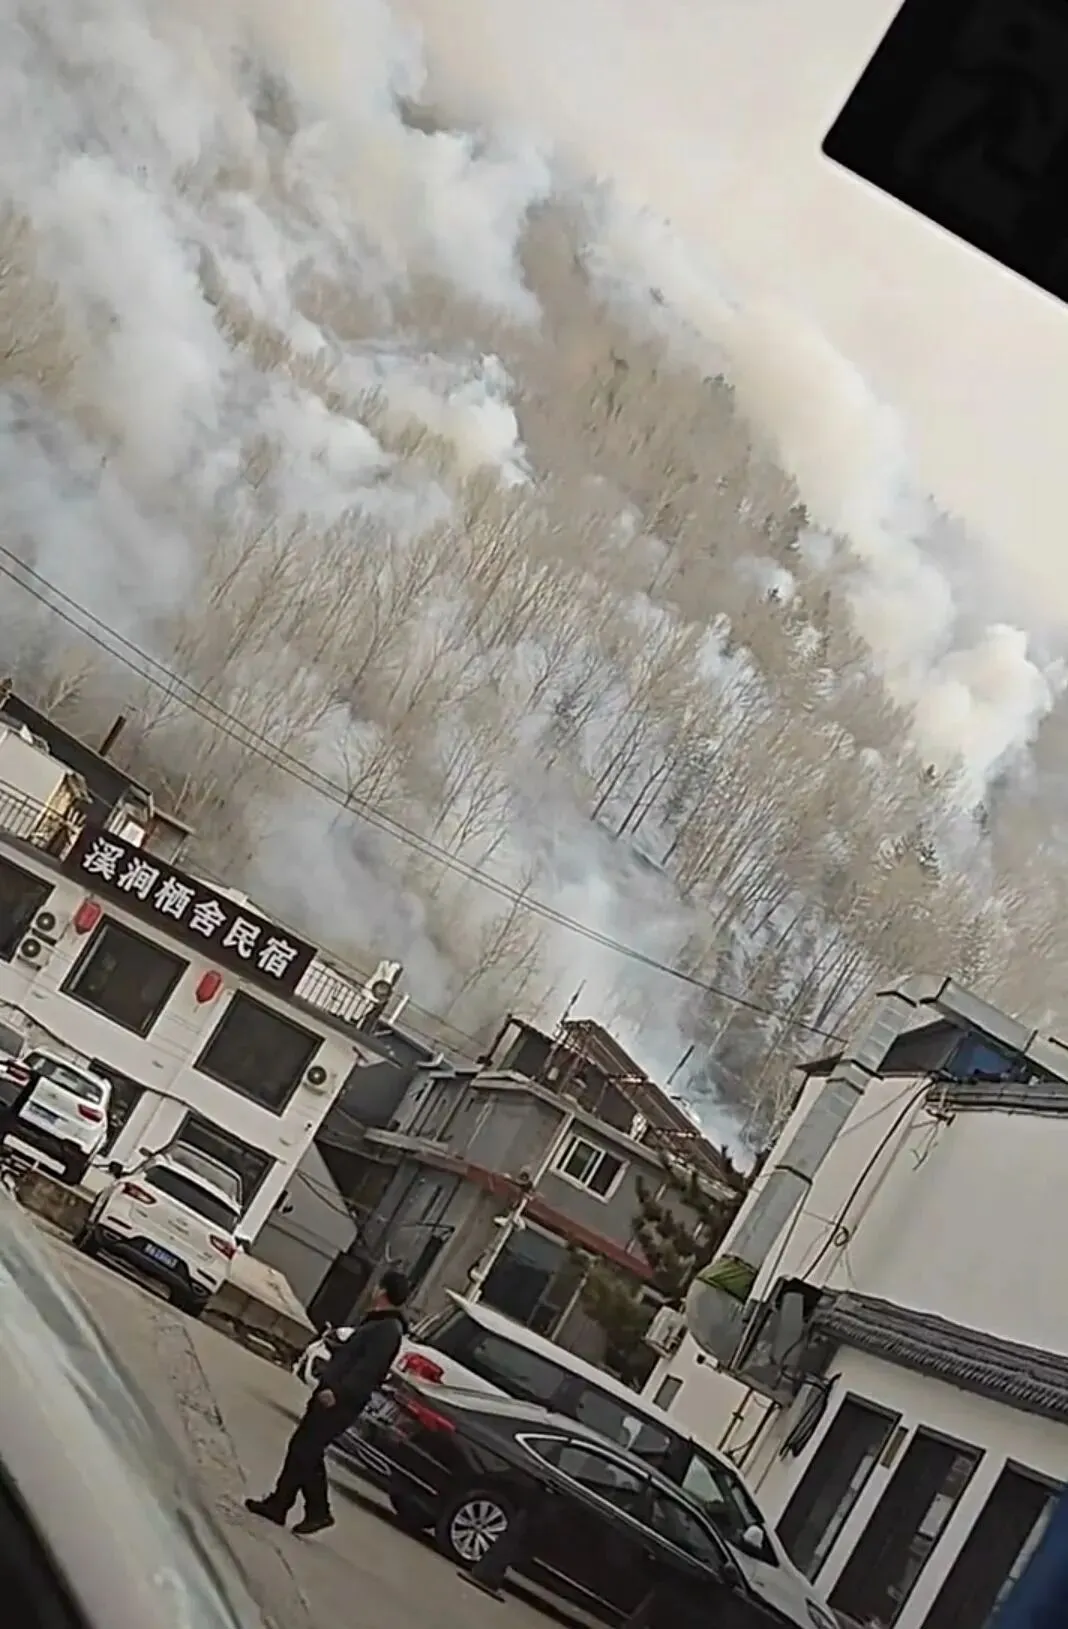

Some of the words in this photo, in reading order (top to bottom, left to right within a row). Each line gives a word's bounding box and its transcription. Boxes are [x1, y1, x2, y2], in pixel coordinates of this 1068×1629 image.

[82, 837, 298, 978] 溪涧栖舍民宿
